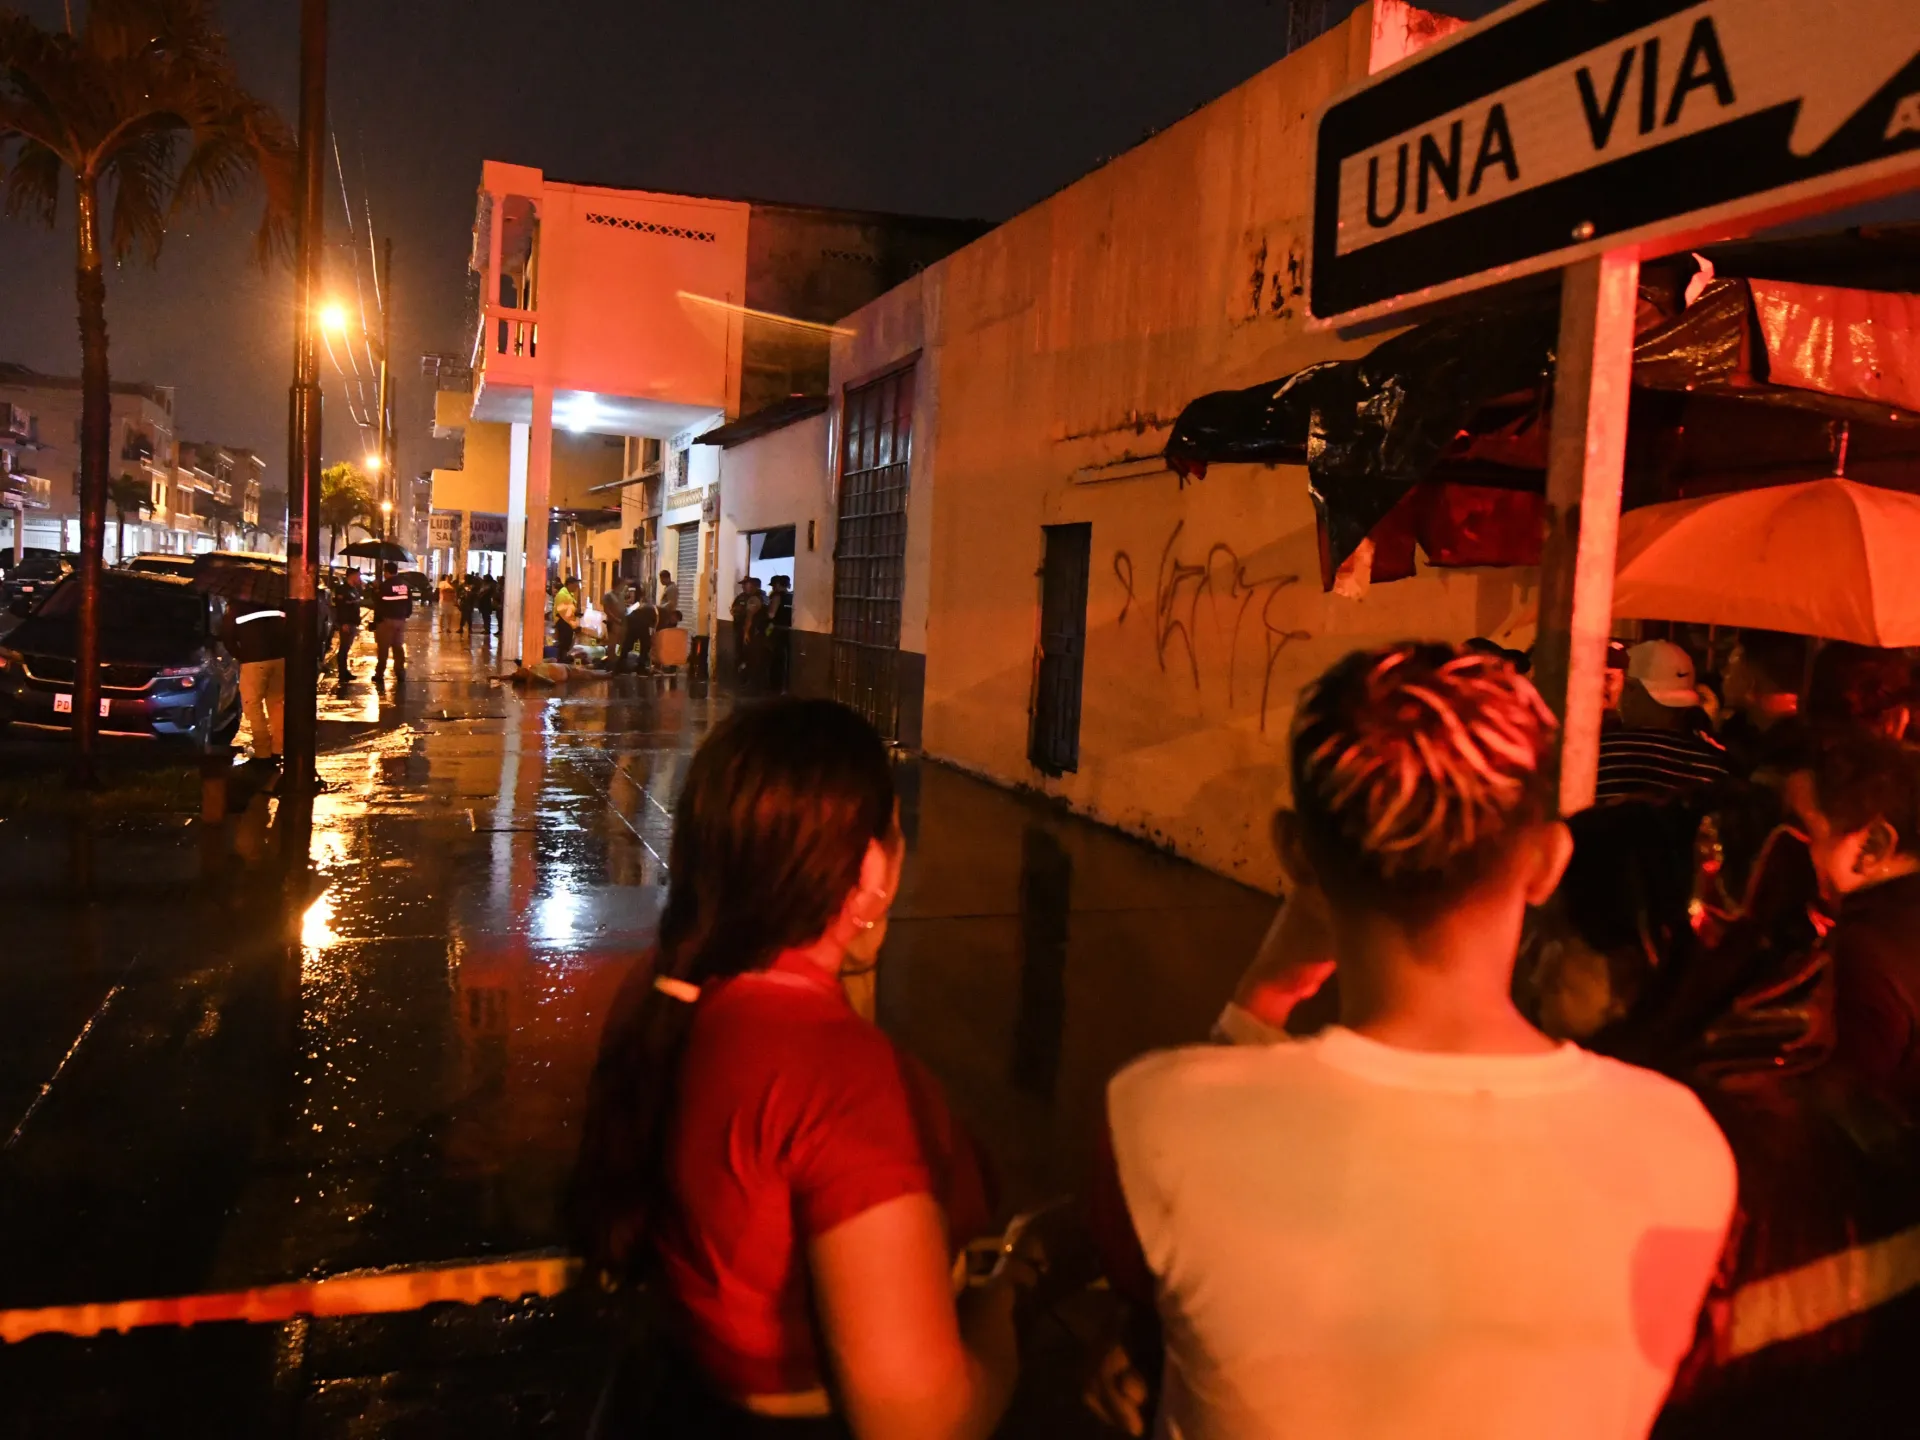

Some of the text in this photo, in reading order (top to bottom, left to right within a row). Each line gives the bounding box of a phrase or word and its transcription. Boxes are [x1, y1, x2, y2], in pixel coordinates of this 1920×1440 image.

[1365, 15, 1737, 229] UNA VIA
[430, 519, 504, 533] LUBRADORA
